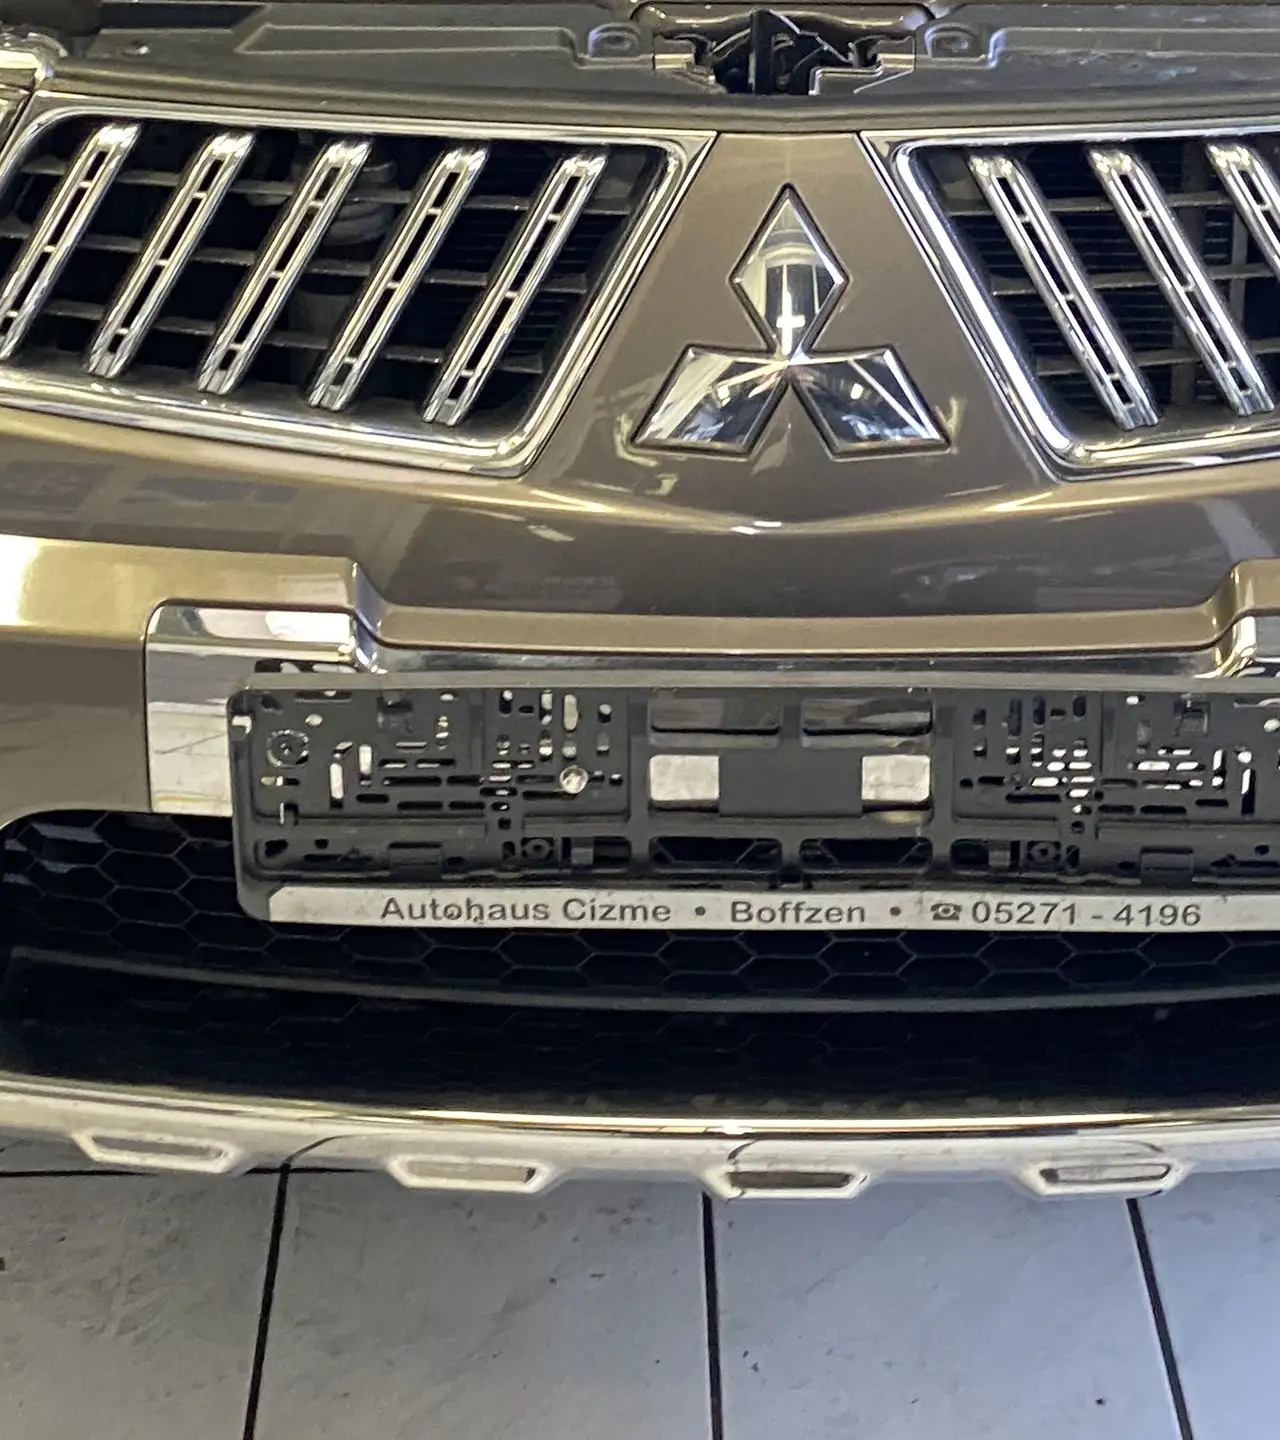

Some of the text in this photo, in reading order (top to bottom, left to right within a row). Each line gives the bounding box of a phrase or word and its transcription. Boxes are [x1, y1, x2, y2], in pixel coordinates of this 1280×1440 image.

[380, 896, 551, 923] Autohaus
[561, 897, 671, 923] Cizme
[730, 899, 866, 925] Boffzen
[971, 901, 1076, 927] 05271
[1112, 902, 1202, 928] 4196
